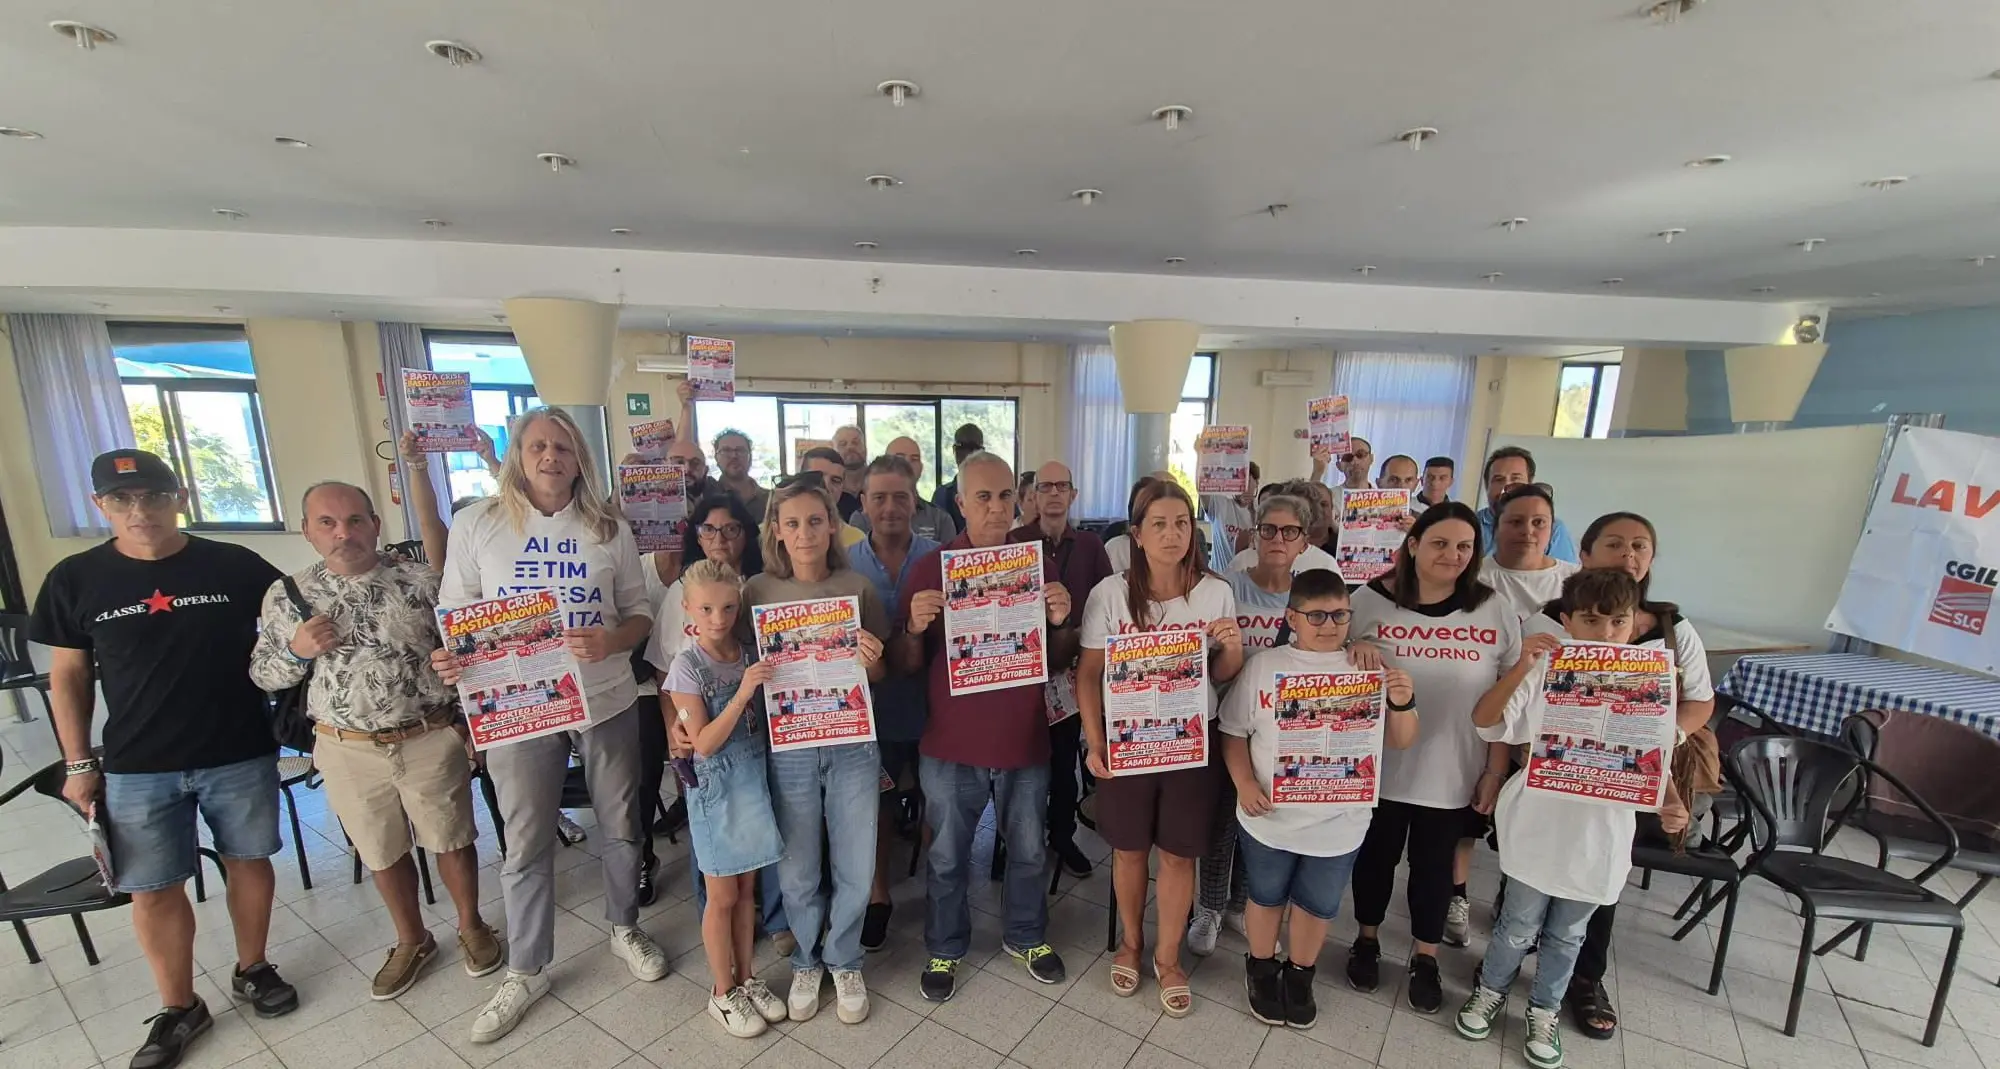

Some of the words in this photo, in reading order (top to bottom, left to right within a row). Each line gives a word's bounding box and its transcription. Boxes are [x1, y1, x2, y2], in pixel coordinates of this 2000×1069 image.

[626, 468, 653, 476] BASTA
[524, 537, 548, 552] AI
[558, 538, 577, 554] di
[950, 565, 984, 580] BASTA
[986, 552, 1036, 572] CAROVITA!
[953, 552, 995, 568] BASTA
[544, 562, 586, 578] TIM
[1946, 560, 1998, 586] CGIL
[95, 604, 146, 622] CLASSE
[172, 594, 230, 607] OPERAIA
[452, 602, 502, 623] BASTA
[765, 605, 808, 622] BASTA
[449, 617, 492, 636] BASTA
[493, 600, 554, 623] CAROVITA!
[762, 620, 798, 634] BASTA
[800, 608, 851, 626] CAROVITA!
[1952, 612, 1982, 632] SLC
[1112, 650, 1144, 662] BASTA
[1146, 641, 1198, 656] CAROVITA!
[1116, 636, 1154, 652] BASTA
[970, 657, 1000, 667] CORTEO
[1001, 652, 1034, 662] CITTADINO
[1396, 646, 1480, 662] LIVORNO
[1561, 646, 1616, 660] BASTA
[1554, 660, 1600, 670] BASTA
[1603, 660, 1666, 672] CAROVITA!
[964, 674, 992, 686] SABATO
[1002, 668, 1032, 680] OTTOBRE
[1286, 676, 1330, 689] BASTA
[1280, 688, 1318, 700] BASTA
[1320, 681, 1378, 696] CAROVITA!
[494, 707, 530, 721] CORTEO
[532, 698, 570, 712] CITTADINO
[792, 712, 823, 723] CORTEO
[824, 710, 858, 719] CITTADINO
[489, 726, 524, 740] SABATO
[535, 714, 572, 728] OTTOBRE
[786, 731, 816, 741] SABATO
[826, 725, 858, 735] OTTOBRE
[1130, 742, 1160, 750] CORTEO
[1161, 738, 1194, 747] CITTADINO
[1122, 758, 1152, 768] SABATO
[1161, 754, 1193, 763] OTTOBRE
[1557, 763, 1598, 775] CORTEO
[1600, 770, 1647, 781] CITTADINO
[1543, 779, 1582, 792] SABATO
[1595, 787, 1641, 800] OTTOBRE
